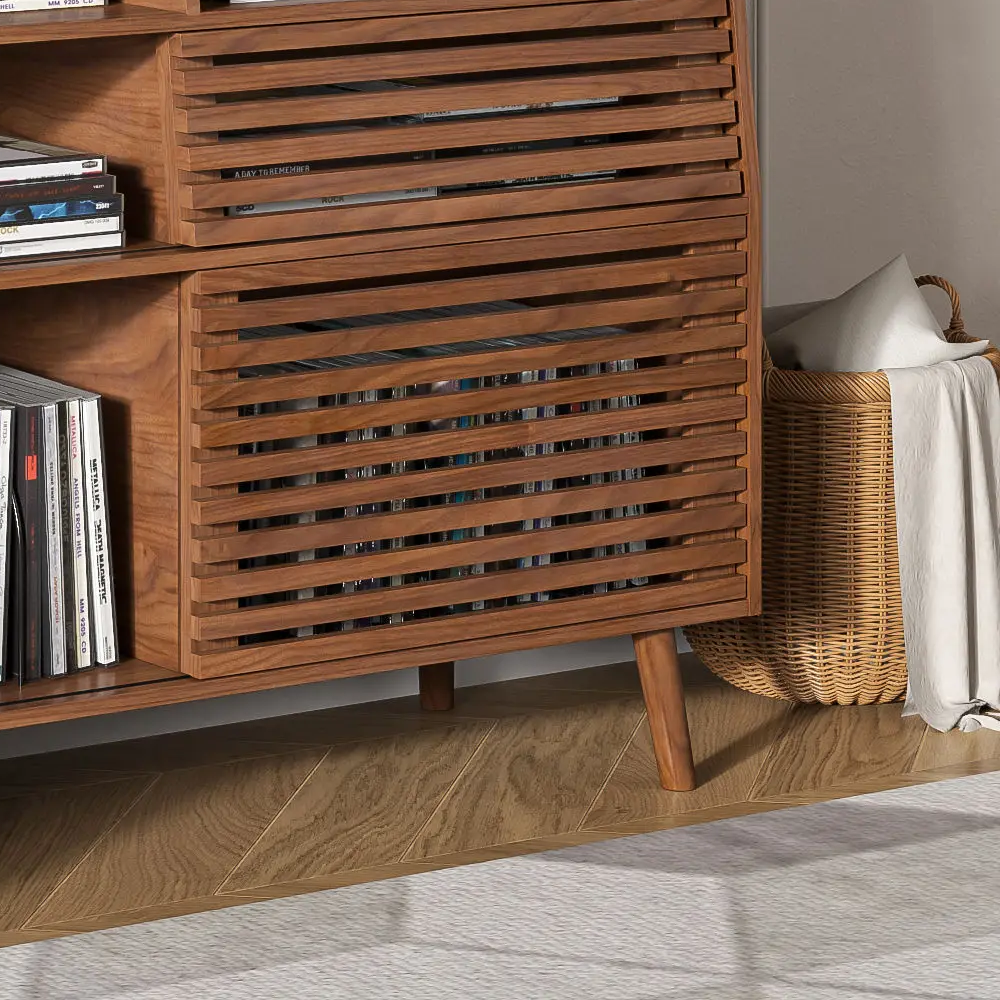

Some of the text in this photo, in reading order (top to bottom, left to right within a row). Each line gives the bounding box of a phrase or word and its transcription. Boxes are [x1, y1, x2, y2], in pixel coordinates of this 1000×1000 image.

[242, 170, 258, 178] DAY
[270, 165, 310, 175] REMEMBER
[70, 416, 78, 459] METALLICA
[0, 476, 7, 500] Olga
[80, 599, 86, 613] MM
[81, 641, 87, 653] CD
